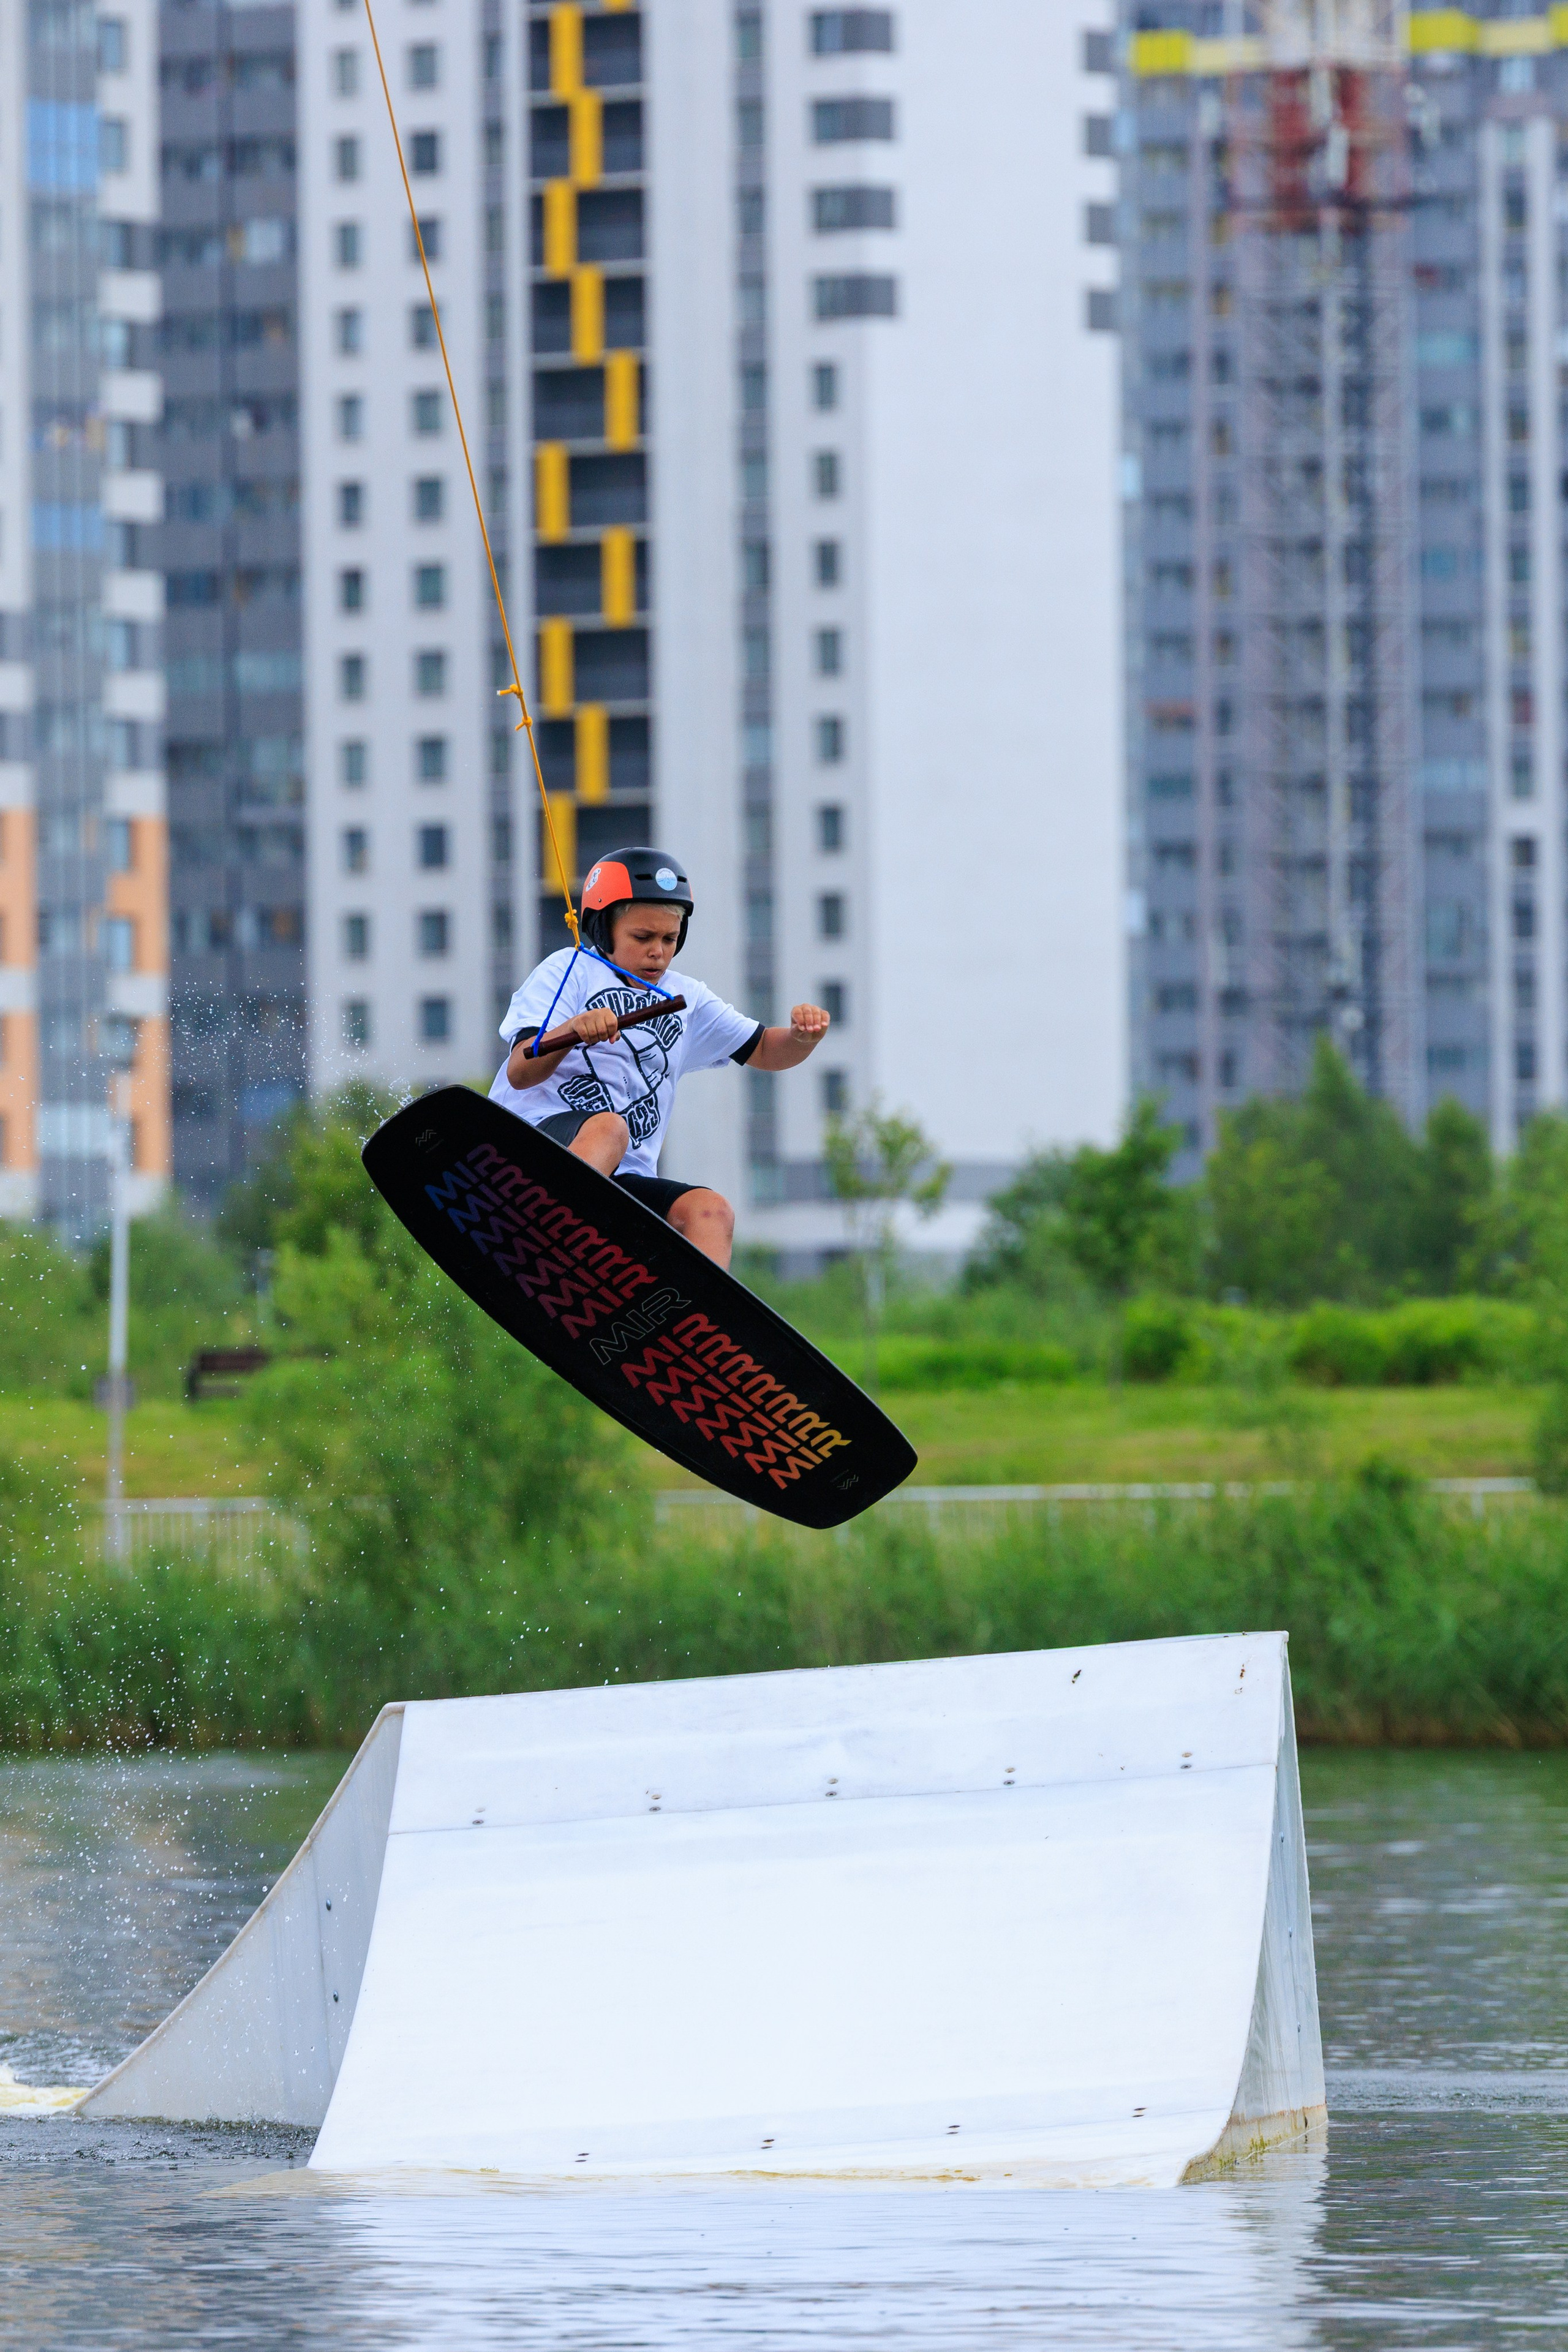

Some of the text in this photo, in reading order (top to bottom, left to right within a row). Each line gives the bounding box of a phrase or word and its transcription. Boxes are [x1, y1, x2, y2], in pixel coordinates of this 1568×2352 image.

[622, 1097, 658, 1139] 025
[424, 1144, 508, 1210] MIR
[447, 1165, 533, 1234] MIR
[470, 1186, 559, 1255] MIR
[492, 1206, 584, 1276] MIR
[515, 1226, 610, 1298] MIR
[538, 1245, 634, 1318] MIR
[560, 1264, 659, 1340] MIR
[589, 1287, 692, 1365] MIR
[620, 1313, 720, 1388] MIR
[646, 1333, 742, 1406] MIR
[670, 1353, 764, 1423] MIR
[695, 1373, 786, 1441] MIR
[720, 1393, 809, 1458] MIR
[744, 1411, 831, 1474] MIR
[768, 1430, 852, 1490] MIR
